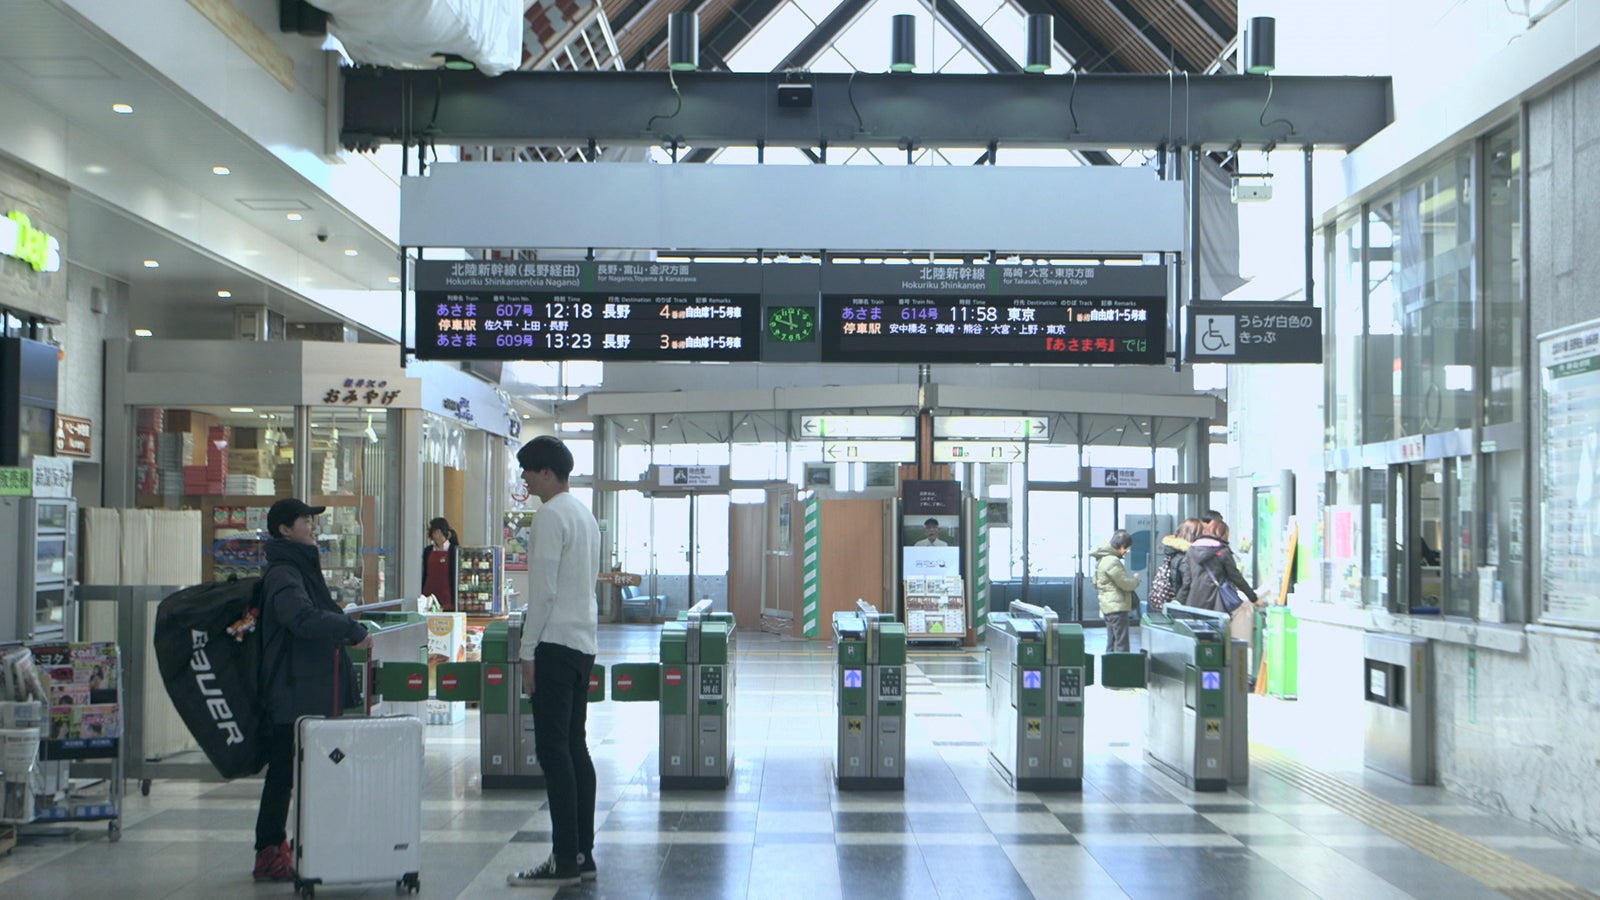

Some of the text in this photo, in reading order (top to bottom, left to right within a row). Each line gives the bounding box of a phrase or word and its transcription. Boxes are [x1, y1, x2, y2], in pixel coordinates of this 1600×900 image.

[920, 266, 986, 280] 北陸新幹線
[446, 278, 482, 286] Hokuriku
[546, 278, 580, 288] Nagano)
[902, 281, 986, 290] Hokuriku Shinkansen
[1070, 278, 1088, 286] Tokyo
[436, 304, 477, 317] あさま
[496, 304, 533, 317] 607号
[545, 303, 592, 318] 12:18
[602, 304, 631, 319] 長野
[842, 307, 882, 320] あさま
[901, 308, 938, 320] 614号
[950, 306, 997, 322] 11:58
[1007, 307, 1036, 321] 東京
[438, 318, 477, 331] 停車駅
[843, 322, 882, 334] 停車駅
[1240, 315, 1313, 328] うらが白色の
[436, 334, 477, 347] あさま
[496, 334, 533, 347] 609号
[545, 333, 592, 348] 13:23
[602, 334, 630, 349] 長野
[1239, 332, 1276, 344] きっぷ
[323, 388, 401, 406] おみやげ
